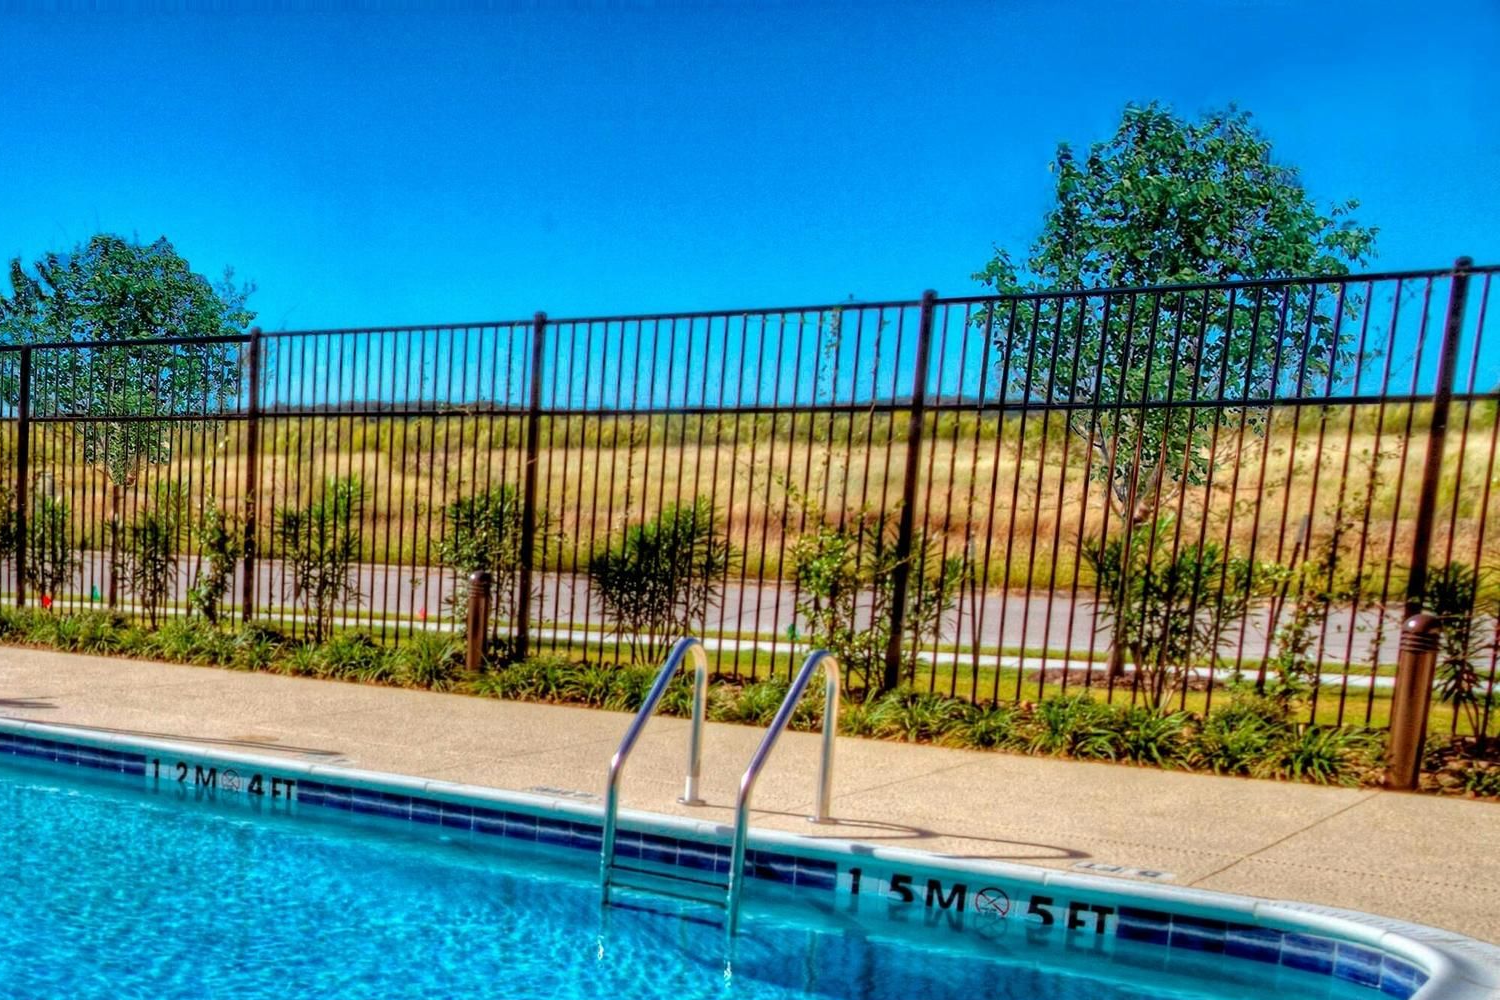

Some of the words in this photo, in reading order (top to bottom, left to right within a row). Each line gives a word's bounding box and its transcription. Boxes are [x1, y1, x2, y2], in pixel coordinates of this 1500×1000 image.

[247, 773, 265, 796] 4
[272, 777, 296, 799] FT
[1068, 901, 1115, 934] FT
